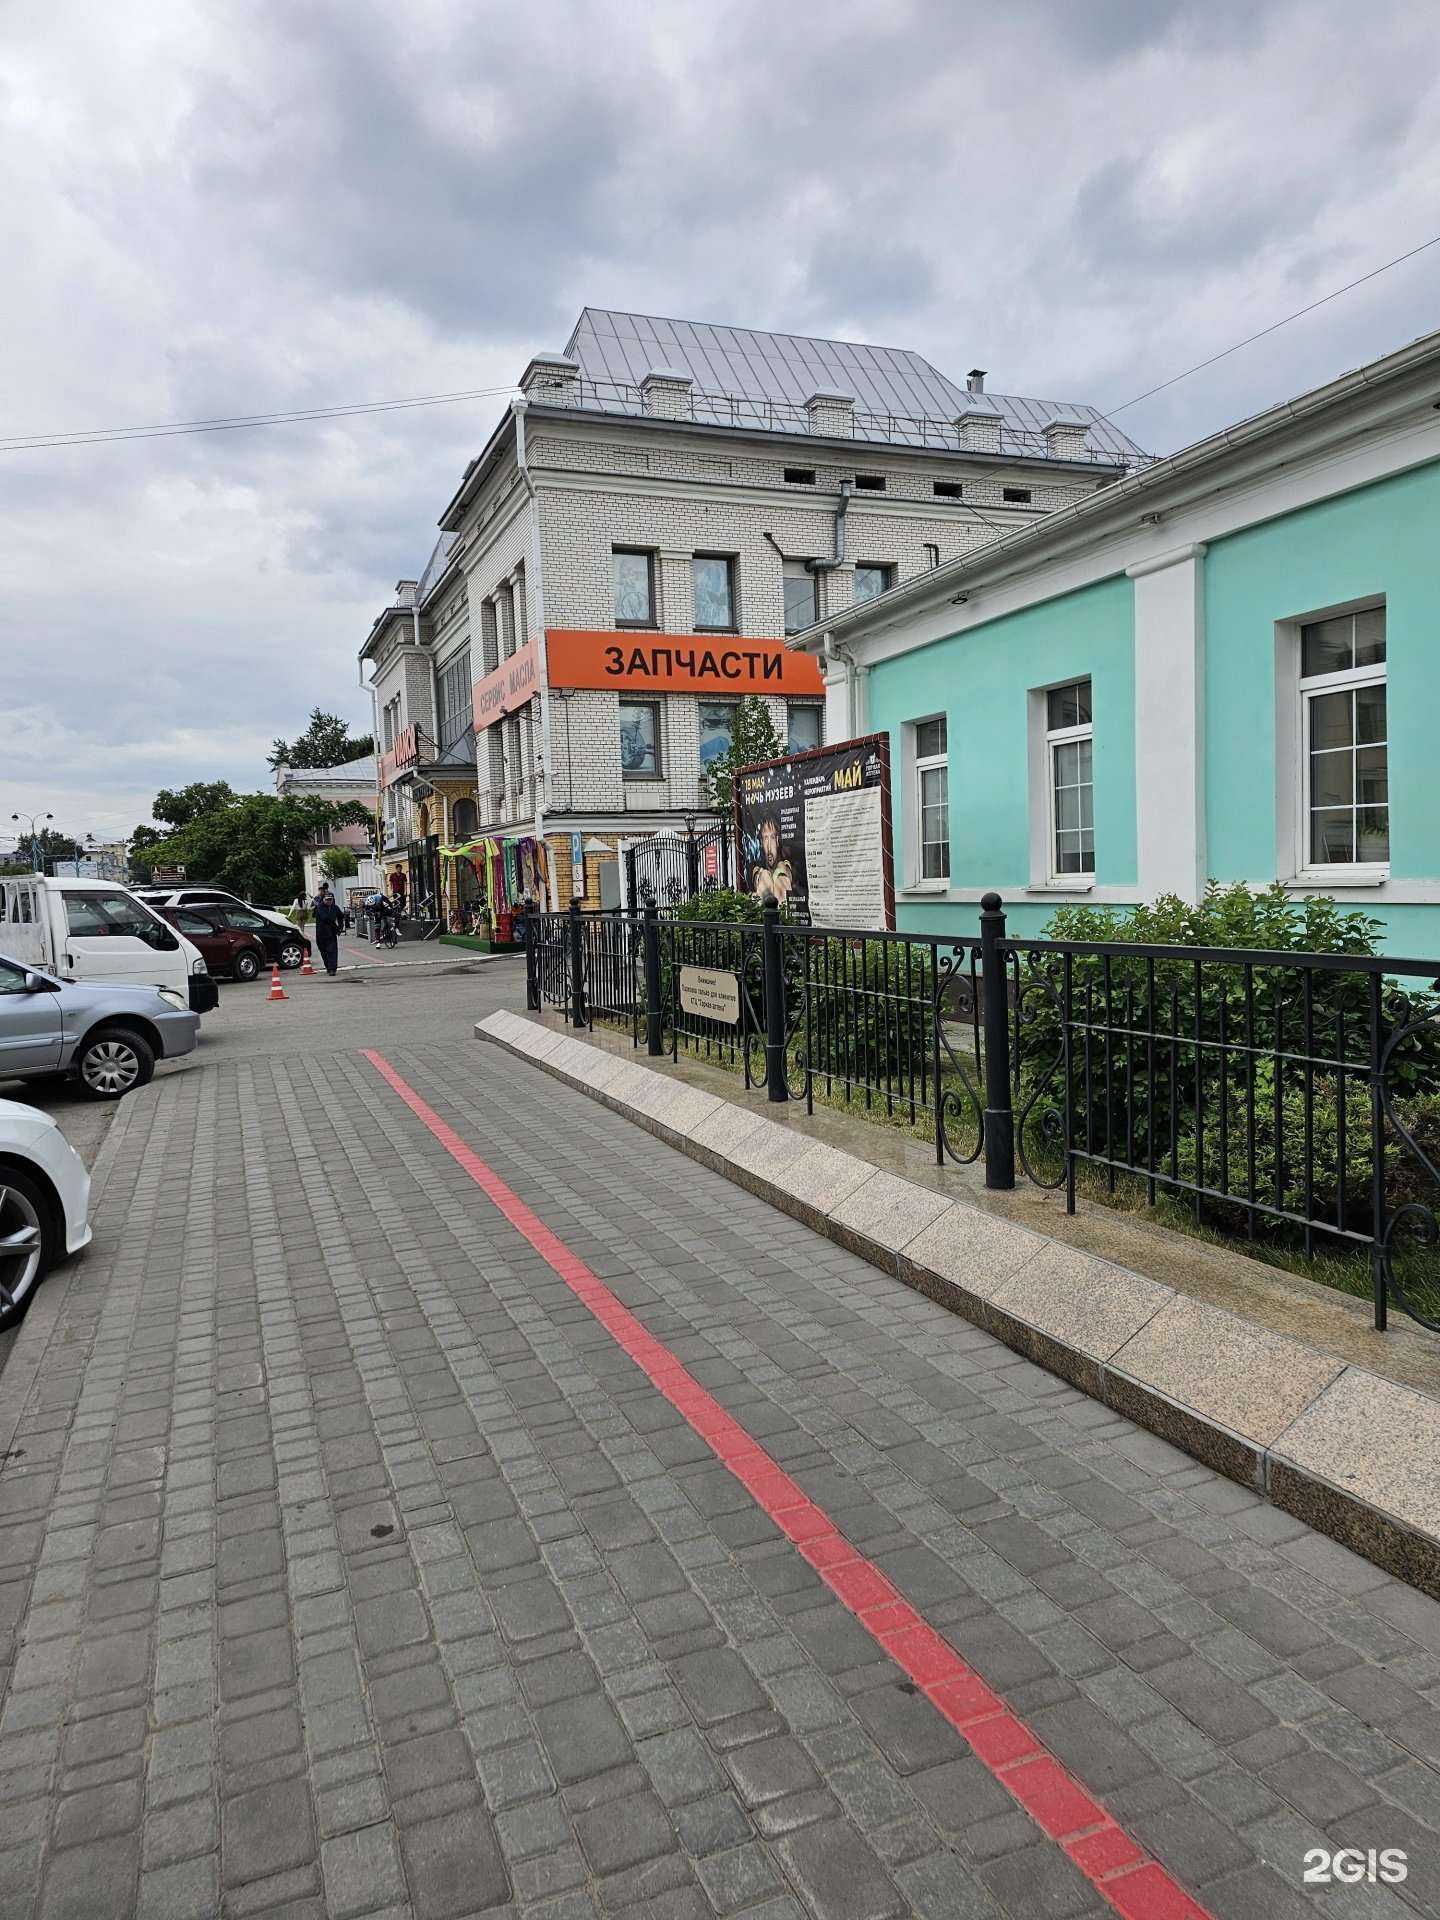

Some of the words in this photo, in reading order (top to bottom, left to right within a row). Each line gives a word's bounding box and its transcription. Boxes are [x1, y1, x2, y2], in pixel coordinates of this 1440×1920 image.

[604, 646, 783, 680] ЗАПЧАСТИ
[480, 679, 505, 714] СЕРВИС
[509, 657, 536, 696] МАСЛА
[751, 776, 765, 789] МАЯ
[834, 760, 862, 791] МАЙ
[745, 792, 764, 805] НОЧЬ
[765, 785, 794, 802] МУЗЕЕВ
